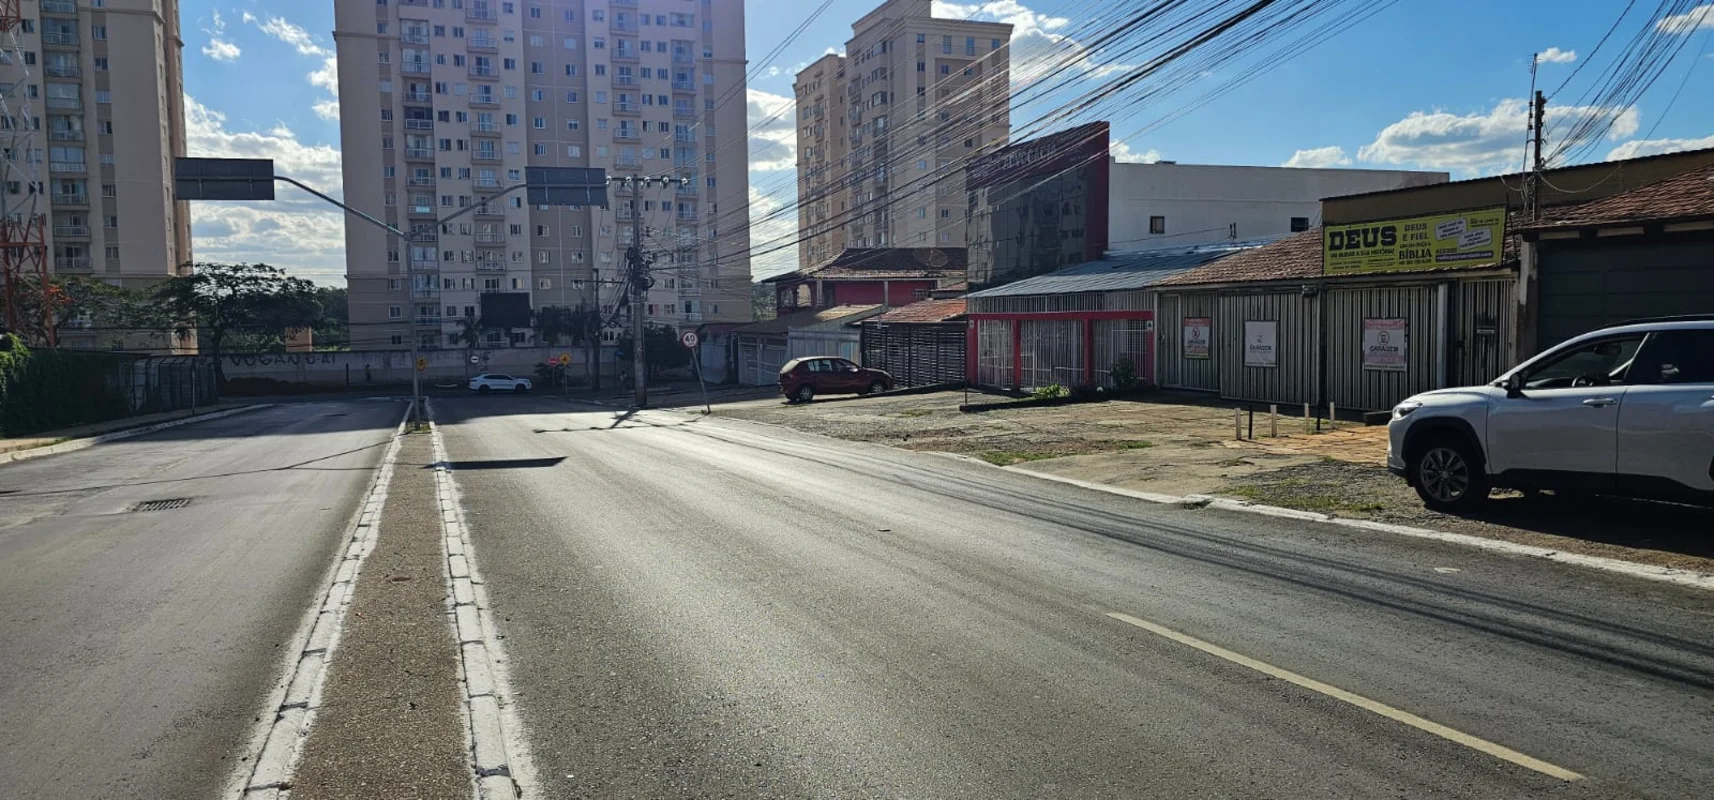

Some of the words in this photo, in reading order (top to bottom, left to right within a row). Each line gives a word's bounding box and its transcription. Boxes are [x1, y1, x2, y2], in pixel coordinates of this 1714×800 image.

[1404, 223, 1428, 232] DEUS
[1329, 226, 1397, 251] DEUS
[1410, 232, 1429, 241] FIEL
[1399, 248, 1432, 260] BÍBLIA
